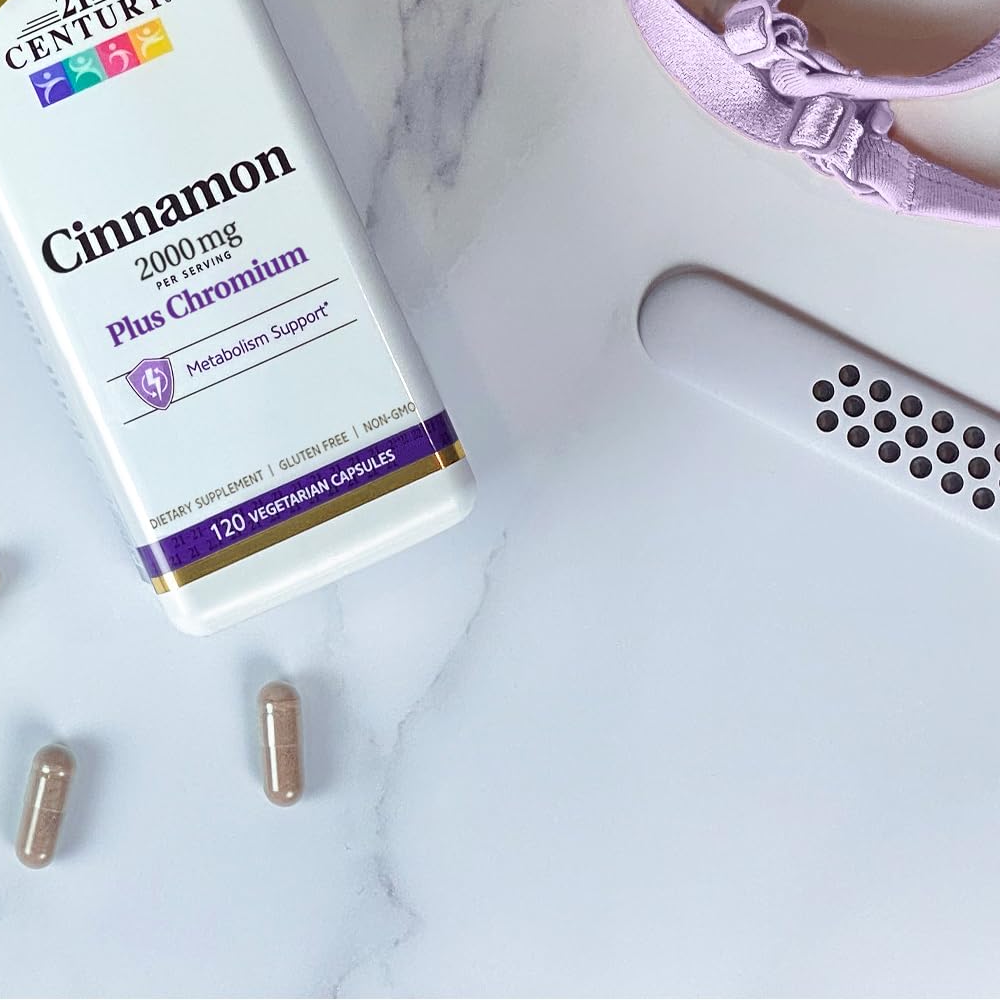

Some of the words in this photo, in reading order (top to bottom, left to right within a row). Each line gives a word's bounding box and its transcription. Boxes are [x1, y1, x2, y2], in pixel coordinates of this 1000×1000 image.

[42, 145, 296, 273] Cinnamon
[135, 237, 195, 281] 2000
[197, 221, 243, 255] mg
[105, 310, 166, 347] Plus
[166, 247, 310, 319] Chromium
[156, 275, 178, 290] PER
[183, 251, 232, 279] SERVING
[187, 333, 270, 376] Metabolism
[150, 502, 193, 529] DIETARY
[195, 470, 264, 509] SUPPLEMENT
[279, 444, 321, 470] GLUTEN
[322, 432, 349, 451] FREE
[363, 401, 416, 433] NON-GMO
[211, 514, 246, 541] 120
[248, 479, 330, 523] VEGETARIAN
[331, 449, 396, 486] CAPSULES
